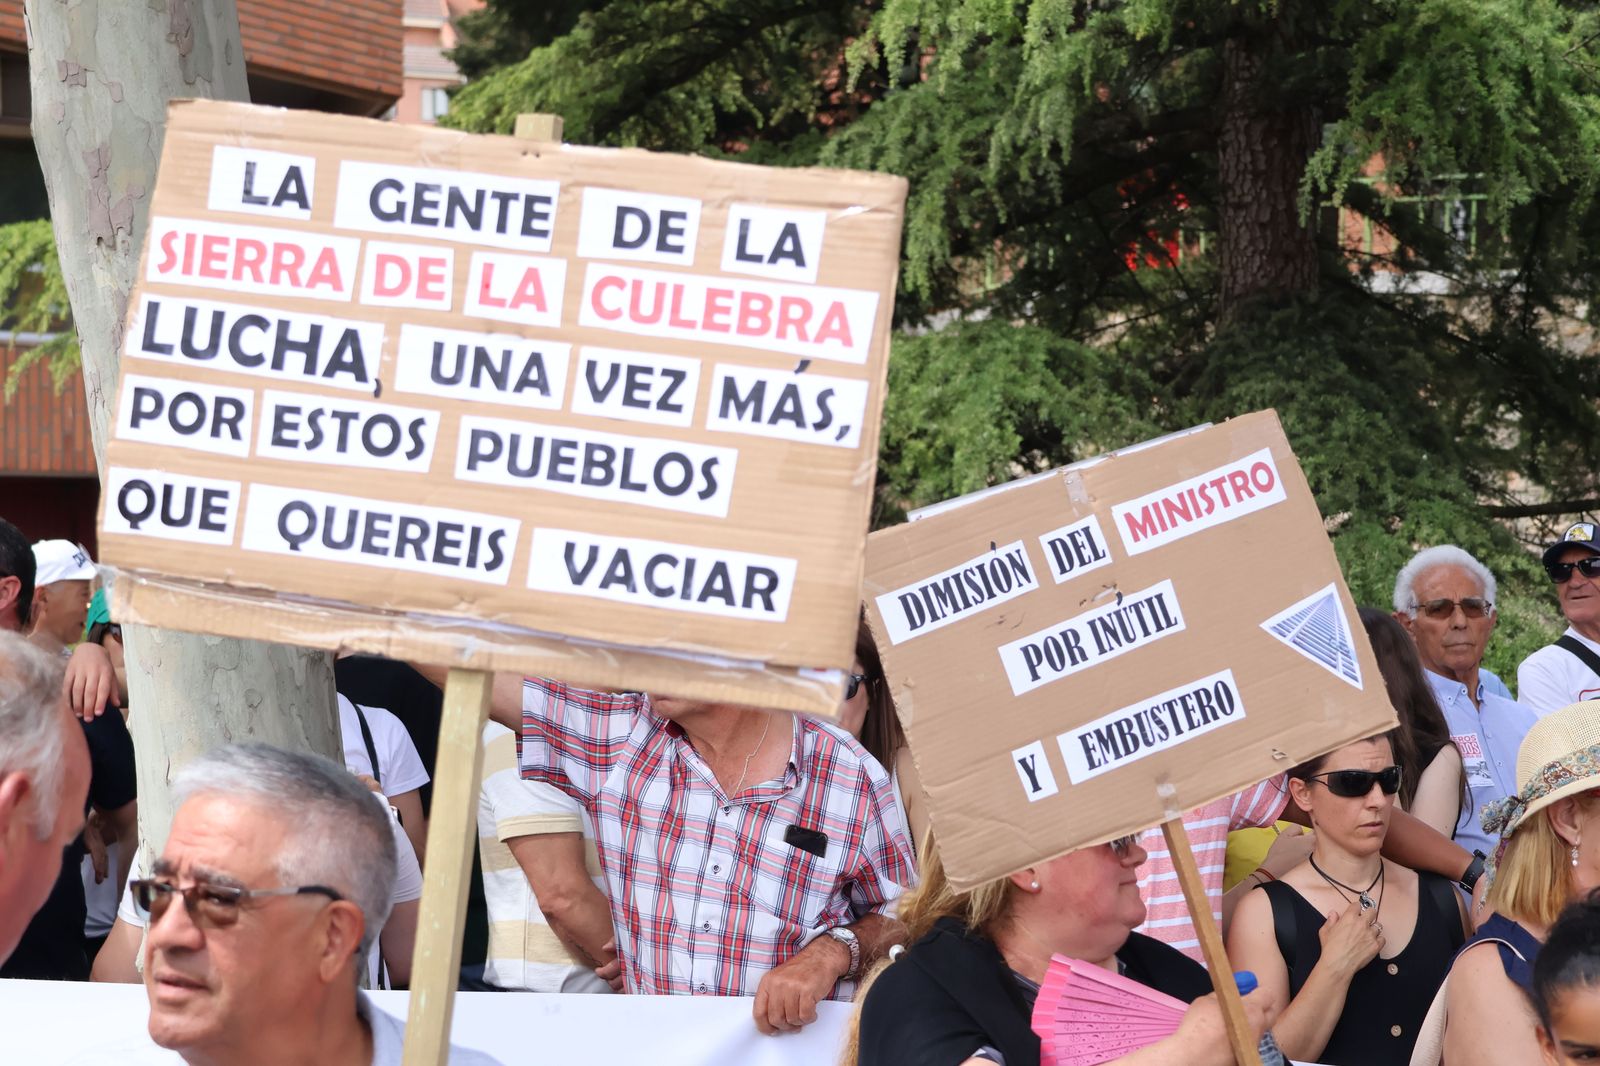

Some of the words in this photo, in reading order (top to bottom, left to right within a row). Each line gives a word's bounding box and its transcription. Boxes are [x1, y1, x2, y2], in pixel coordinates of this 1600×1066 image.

[242, 160, 311, 210] LA
[370, 179, 552, 238] GENTE
[612, 206, 687, 252] DE
[736, 218, 806, 267] LA
[158, 230, 343, 292] SIERRA
[374, 254, 447, 297] DE
[479, 263, 547, 311] LA
[592, 276, 853, 347] CULEBRA
[141, 301, 382, 396] LUCHA,
[431, 343, 551, 396] UNA
[586, 359, 686, 412] VEZ
[719, 359, 851, 439] MÁS,
[130, 387, 245, 440] POR
[271, 405, 426, 461] ESTOS
[467, 429, 719, 500] PUEBLOS
[117, 479, 228, 531] QUE
[277, 500, 505, 571] QUEREIS
[564, 542, 778, 612] VACIAR
[899, 542, 1032, 630] DIMISIÓN
[1049, 526, 1106, 574] DEL
[1124, 462, 1274, 542] MINISTRO
[1021, 628, 1088, 681] POR
[1087, 590, 1178, 653] INÚTIL
[1018, 754, 1040, 792] Y
[1079, 681, 1235, 770] EMBUSTERO
